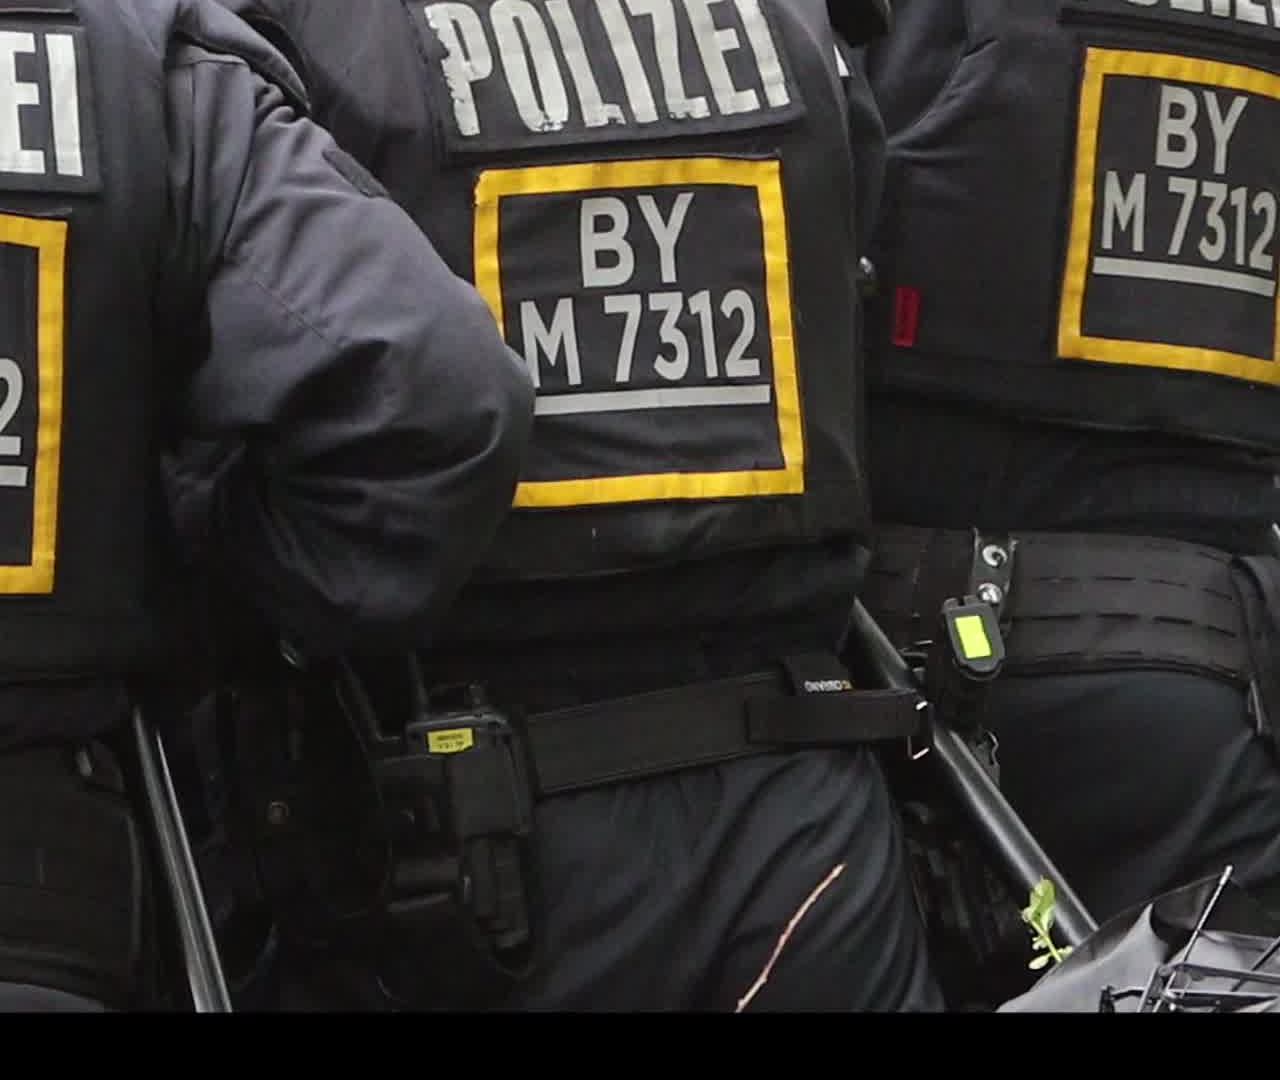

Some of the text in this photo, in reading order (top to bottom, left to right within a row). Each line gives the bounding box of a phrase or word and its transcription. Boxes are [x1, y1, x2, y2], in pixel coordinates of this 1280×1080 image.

[1155, 85, 1248, 175] BY
[580, 192, 695, 288] BY
[1101, 171, 1277, 273] M 7312
[520, 289, 760, 387] M 7312
